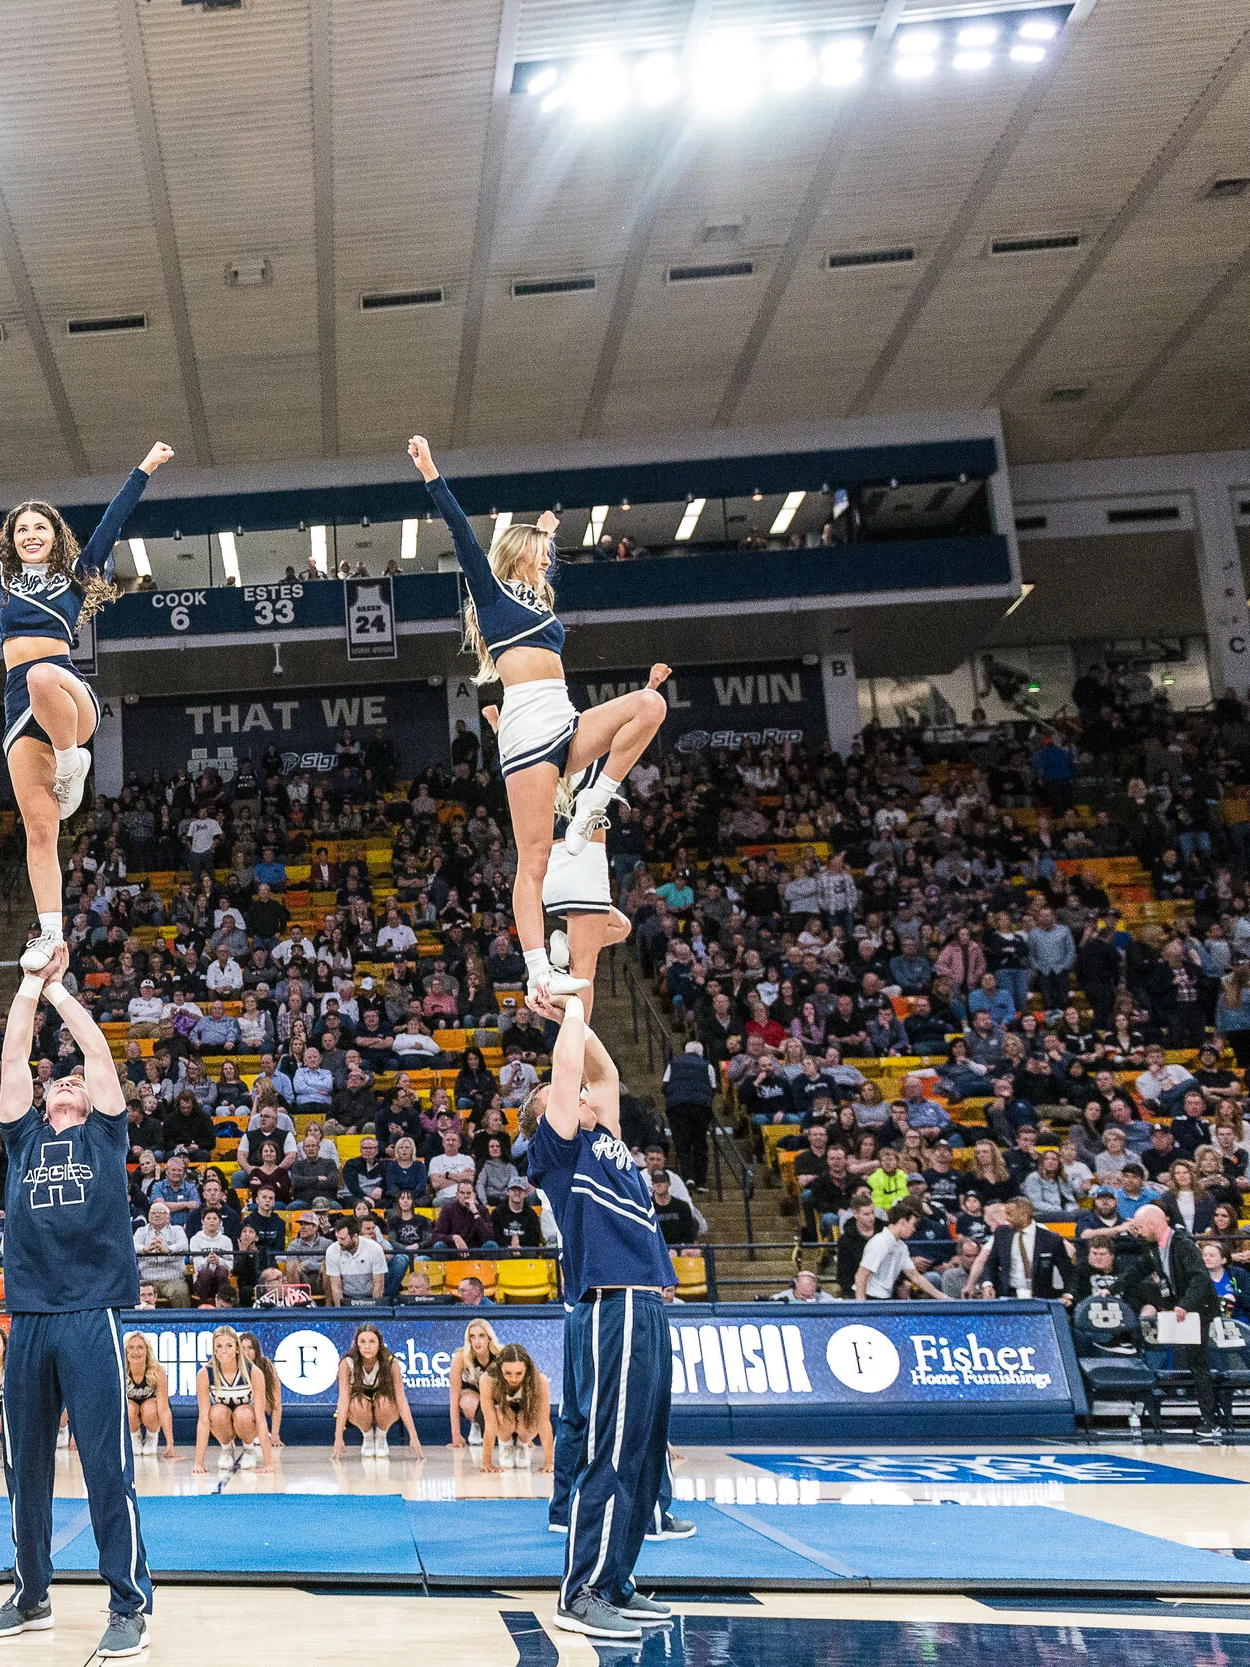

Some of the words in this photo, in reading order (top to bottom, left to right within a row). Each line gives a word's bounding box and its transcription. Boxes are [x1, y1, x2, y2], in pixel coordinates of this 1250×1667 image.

[152, 592, 207, 608] COOK
[244, 584, 304, 601] ESTES
[170, 606, 190, 630] 6
[254, 600, 295, 625] 33
[355, 614, 386, 634] 24
[1230, 636, 1246, 653] C
[832, 660, 846, 676] B
[456, 682, 470, 698] A
[713, 673, 801, 706] WIN
[100, 703, 114, 718] A
[186, 701, 299, 735] THAT
[321, 696, 388, 727] WE
[23, 1163, 94, 1184] AGGIES
[298, 1345, 318, 1378] F
[910, 1333, 1036, 1371] Fisher
[910, 1370, 960, 1385] Home
[963, 1369, 1051, 1389] Furnishings
